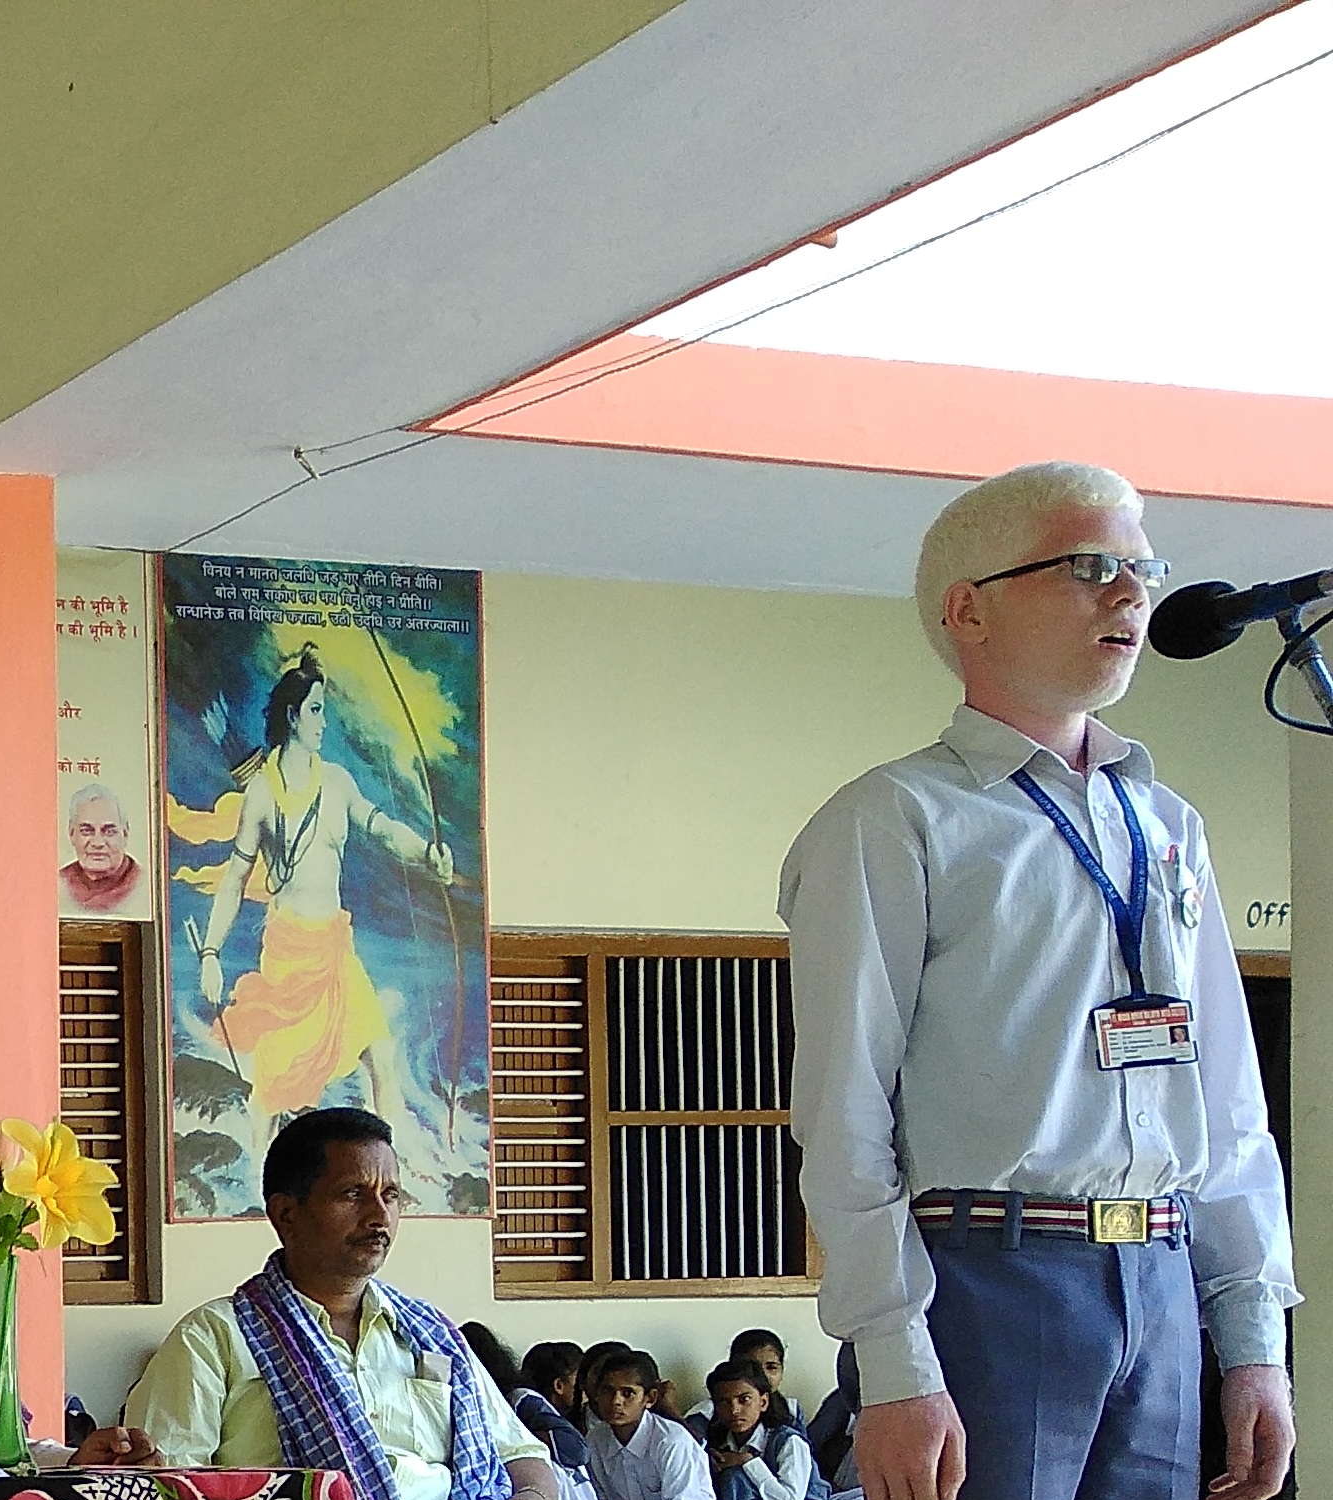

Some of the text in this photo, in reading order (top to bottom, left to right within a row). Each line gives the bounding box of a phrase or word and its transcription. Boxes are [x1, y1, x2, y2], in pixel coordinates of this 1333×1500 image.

[202, 561, 231, 578] विनय
[236, 567, 244, 579] न
[248, 567, 278, 580] मानत
[391, 572, 411, 588] दिन
[70, 596, 85, 611] की
[90, 596, 115, 617] भूमि
[119, 595, 129, 614] है
[240, 587, 260, 600] राम
[386, 596, 395, 608] न
[69, 620, 83, 636] की
[89, 621, 114, 642] भूमि
[117, 620, 127, 638] है
[387, 616, 402, 629] उर
[58, 701, 81, 719] और
[58, 757, 101, 777] को कोई
